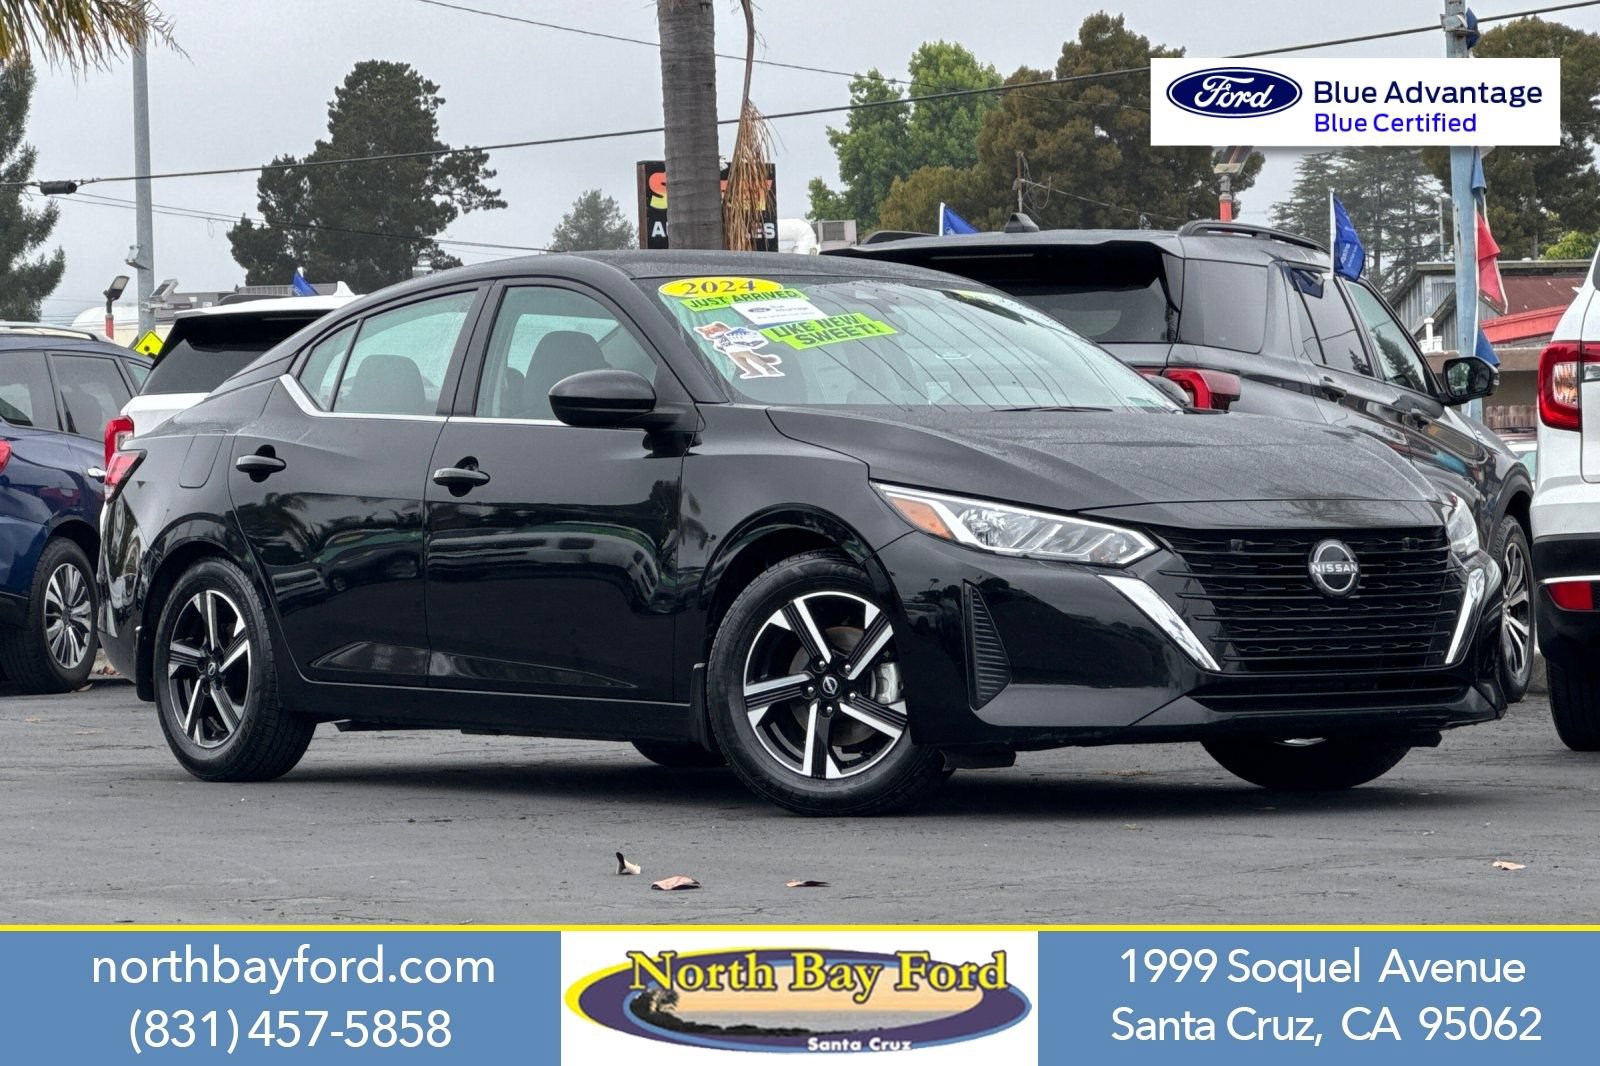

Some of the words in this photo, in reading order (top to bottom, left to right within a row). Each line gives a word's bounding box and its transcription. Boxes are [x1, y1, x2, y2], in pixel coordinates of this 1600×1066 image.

[681, 280, 757, 295] 2024
[690, 296, 728, 308] JUST
[733, 290, 799, 303] ARRIVED
[770, 321, 817, 338] LIKE
[795, 323, 882, 345] SWEET!
[1311, 563, 1358, 574] NISSAN
